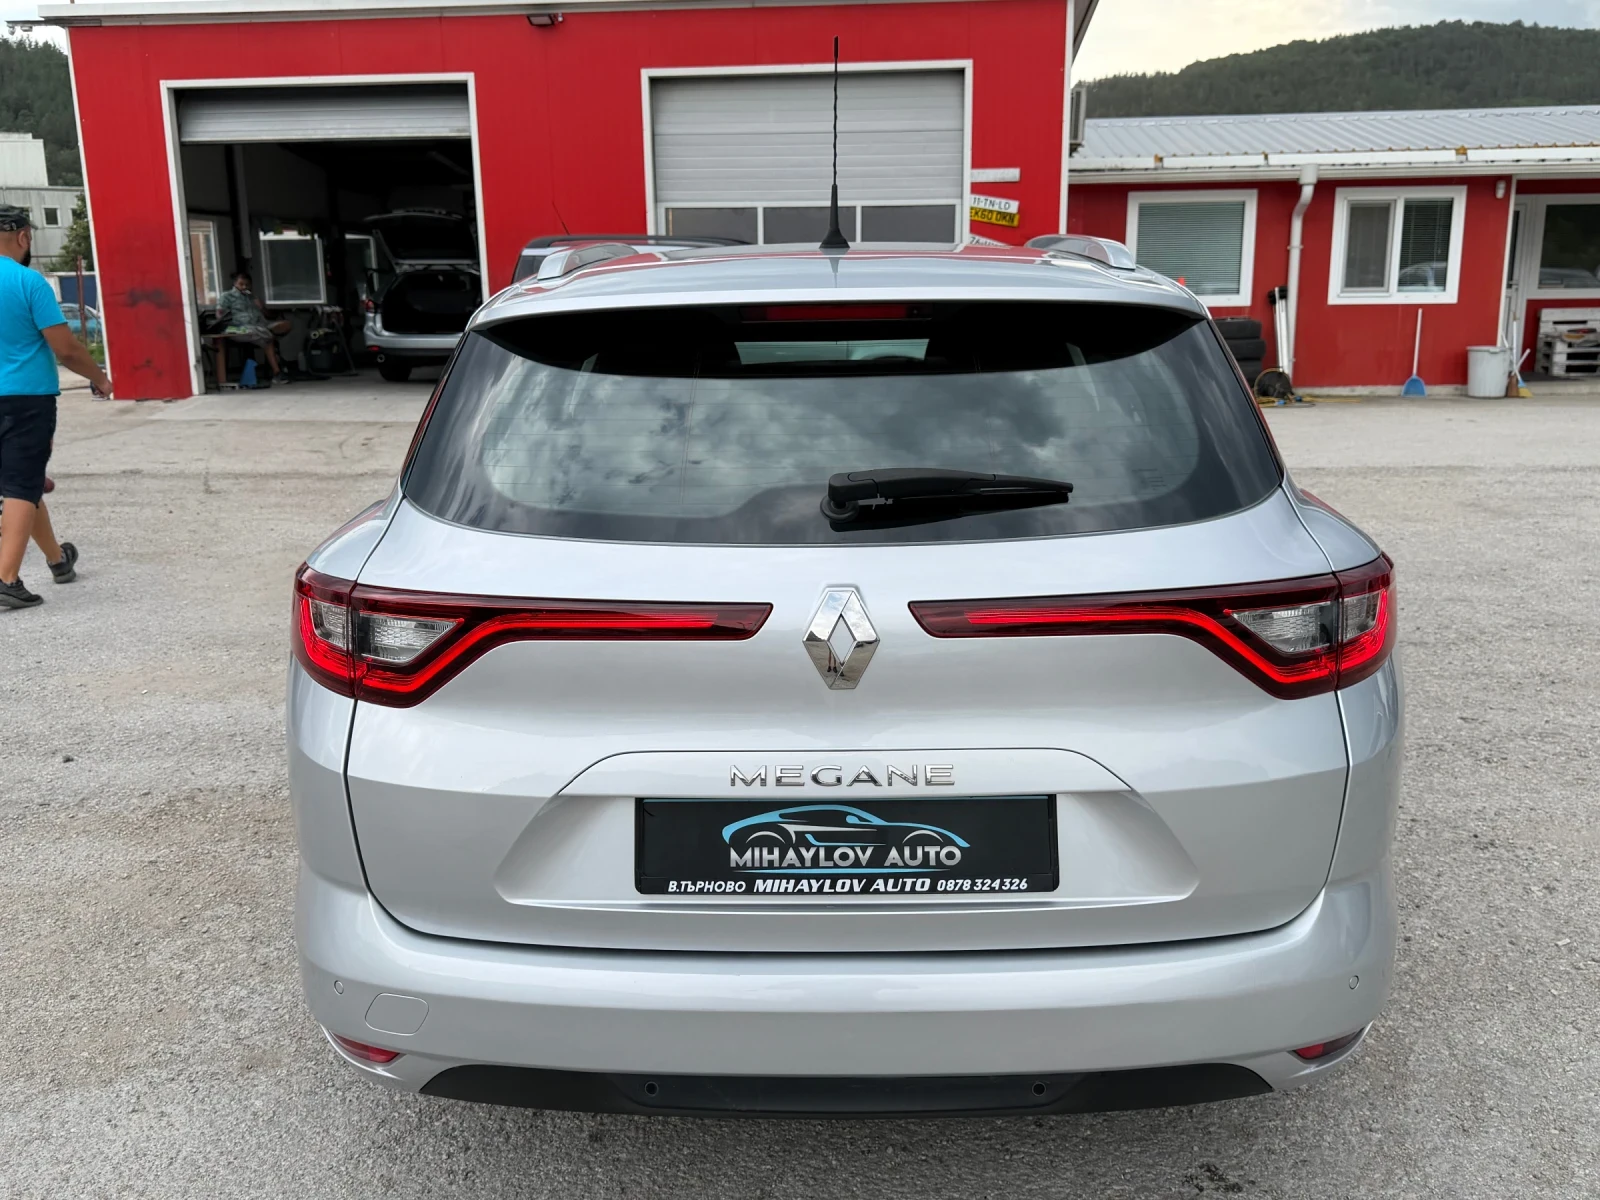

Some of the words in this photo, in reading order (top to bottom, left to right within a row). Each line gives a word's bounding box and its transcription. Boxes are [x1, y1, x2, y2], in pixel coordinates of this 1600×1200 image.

[729, 764, 955, 787] MEGANE
[729, 846, 875, 868] MIHAYLOV
[883, 845, 962, 867] AUTO
[667, 880, 747, 893] В.ТЪРНОВО
[753, 879, 867, 893] MIHAYLOV
[869, 878, 931, 892] AUTO
[936, 879, 972, 891] 0878
[973, 878, 1000, 891] 324
[1001, 878, 1028, 890] 326
